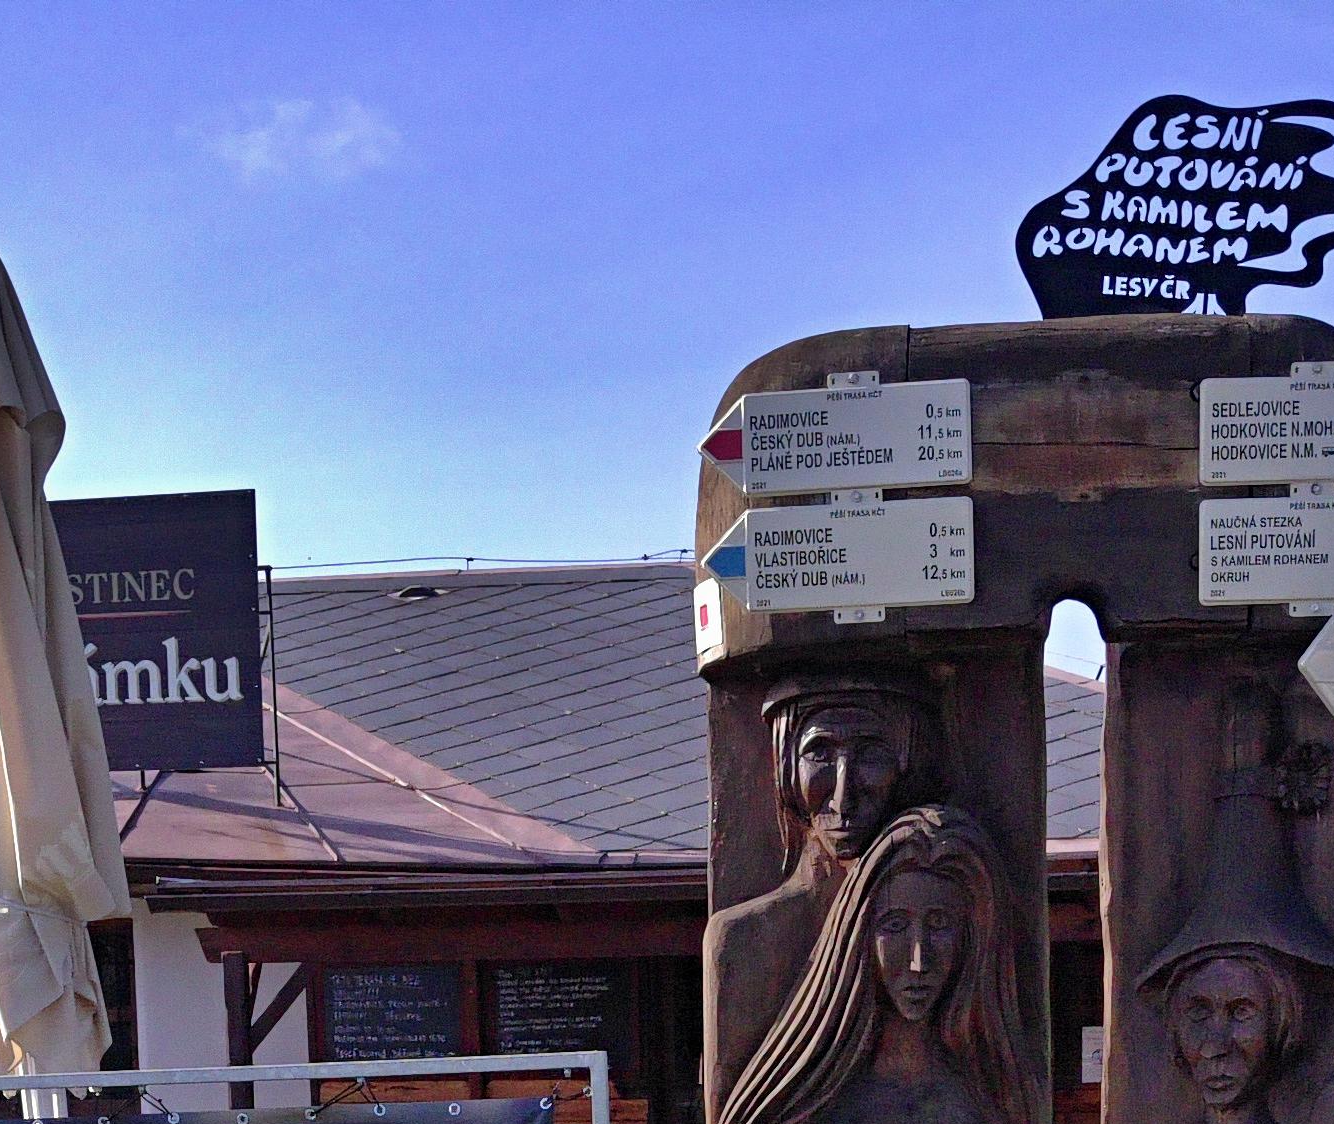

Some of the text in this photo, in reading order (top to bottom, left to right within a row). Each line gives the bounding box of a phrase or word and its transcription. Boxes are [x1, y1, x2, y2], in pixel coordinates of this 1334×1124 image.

[1133, 109, 1270, 152] LESNÍ
[1095, 153, 1309, 191] PUTOVÁNÍ
[1061, 190, 1289, 233] S KAMILEM
[1032, 225, 1248, 265] ROHANEM
[1102, 274, 1191, 300] LESY ČR
[749, 403, 961, 431] RADIMOVICE 0,5 km
[1212, 400, 1300, 418] SEDLEJOVICE
[751, 430, 793, 451] ČESKÝ
[797, 432, 823, 448] DUB
[918, 424, 944, 440] 11,5
[947, 428, 962, 438] km
[1211, 422, 1287, 440] HODKOVICE
[796, 453, 823, 469] POD
[918, 446, 944, 461] 20,5
[947, 449, 962, 459] km
[1211, 443, 1287, 461] HODKOVICE
[1291, 443, 1318, 459] N.M.
[1210, 515, 1303, 529] NAUČNÁ STEZKA
[754, 522, 965, 548] RADIMOVICE 0,5 km
[1210, 531, 1247, 550] LESNÍ
[1251, 529, 1316, 549] PUTOVÁNÍ
[755, 544, 965, 568] VLASTIBOŘICE 3 km
[1211, 553, 1329, 567] S KAMILEM ROHANEM
[67, 568, 195, 605] STINEC
[756, 569, 798, 589] ČESKÝ
[802, 571, 828, 587] DUB
[922, 564, 947, 581] 12,5
[950, 569, 965, 579] km
[1211, 571, 1250, 583] OKRUH
[84, 636, 244, 707] mku
